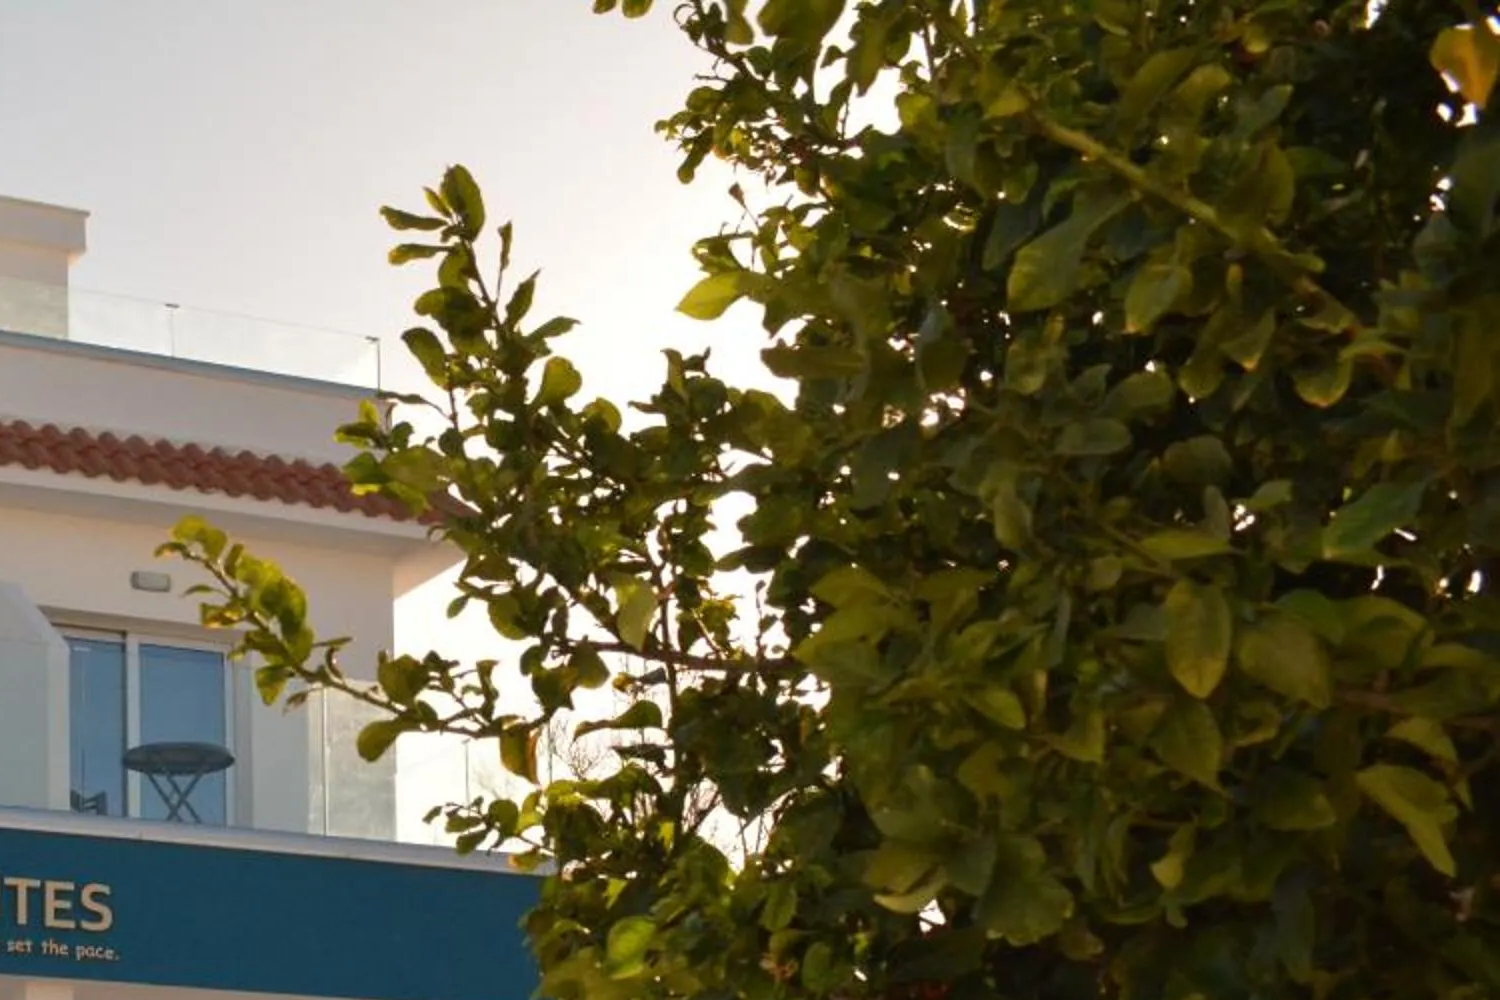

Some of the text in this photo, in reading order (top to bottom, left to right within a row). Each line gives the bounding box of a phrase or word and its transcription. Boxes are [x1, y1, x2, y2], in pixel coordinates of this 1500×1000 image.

[7, 939, 32, 953] set
[42, 938, 69, 955] the
[76, 945, 120, 961] pace.
